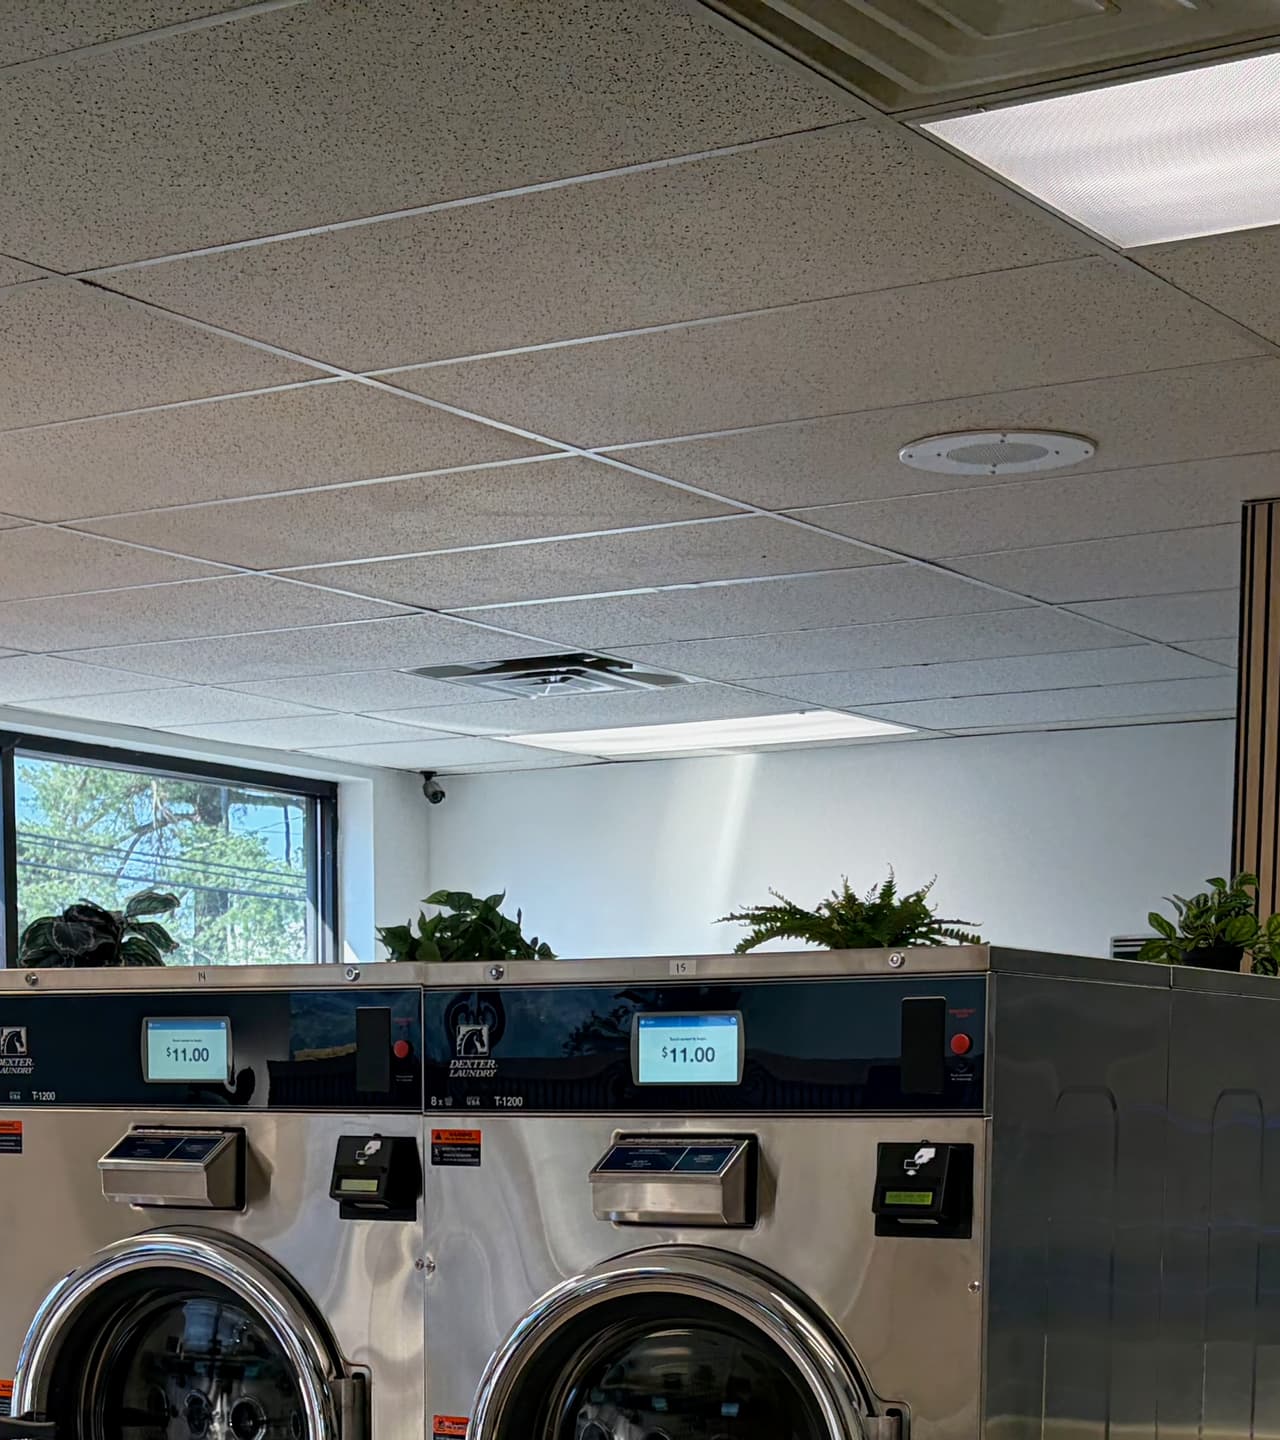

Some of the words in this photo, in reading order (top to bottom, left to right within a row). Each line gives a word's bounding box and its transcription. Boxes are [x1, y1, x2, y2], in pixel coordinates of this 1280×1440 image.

[166, 1046, 210, 1062] $11.00
[661, 1045, 716, 1063] $11.00
[449, 1059, 496, 1069] DEXTER
[449, 1069, 497, 1078] LAUNDRY
[32, 1091, 56, 1101] T-1200
[431, 1096, 437, 1106] 8
[494, 1096, 523, 1107] T-1200
